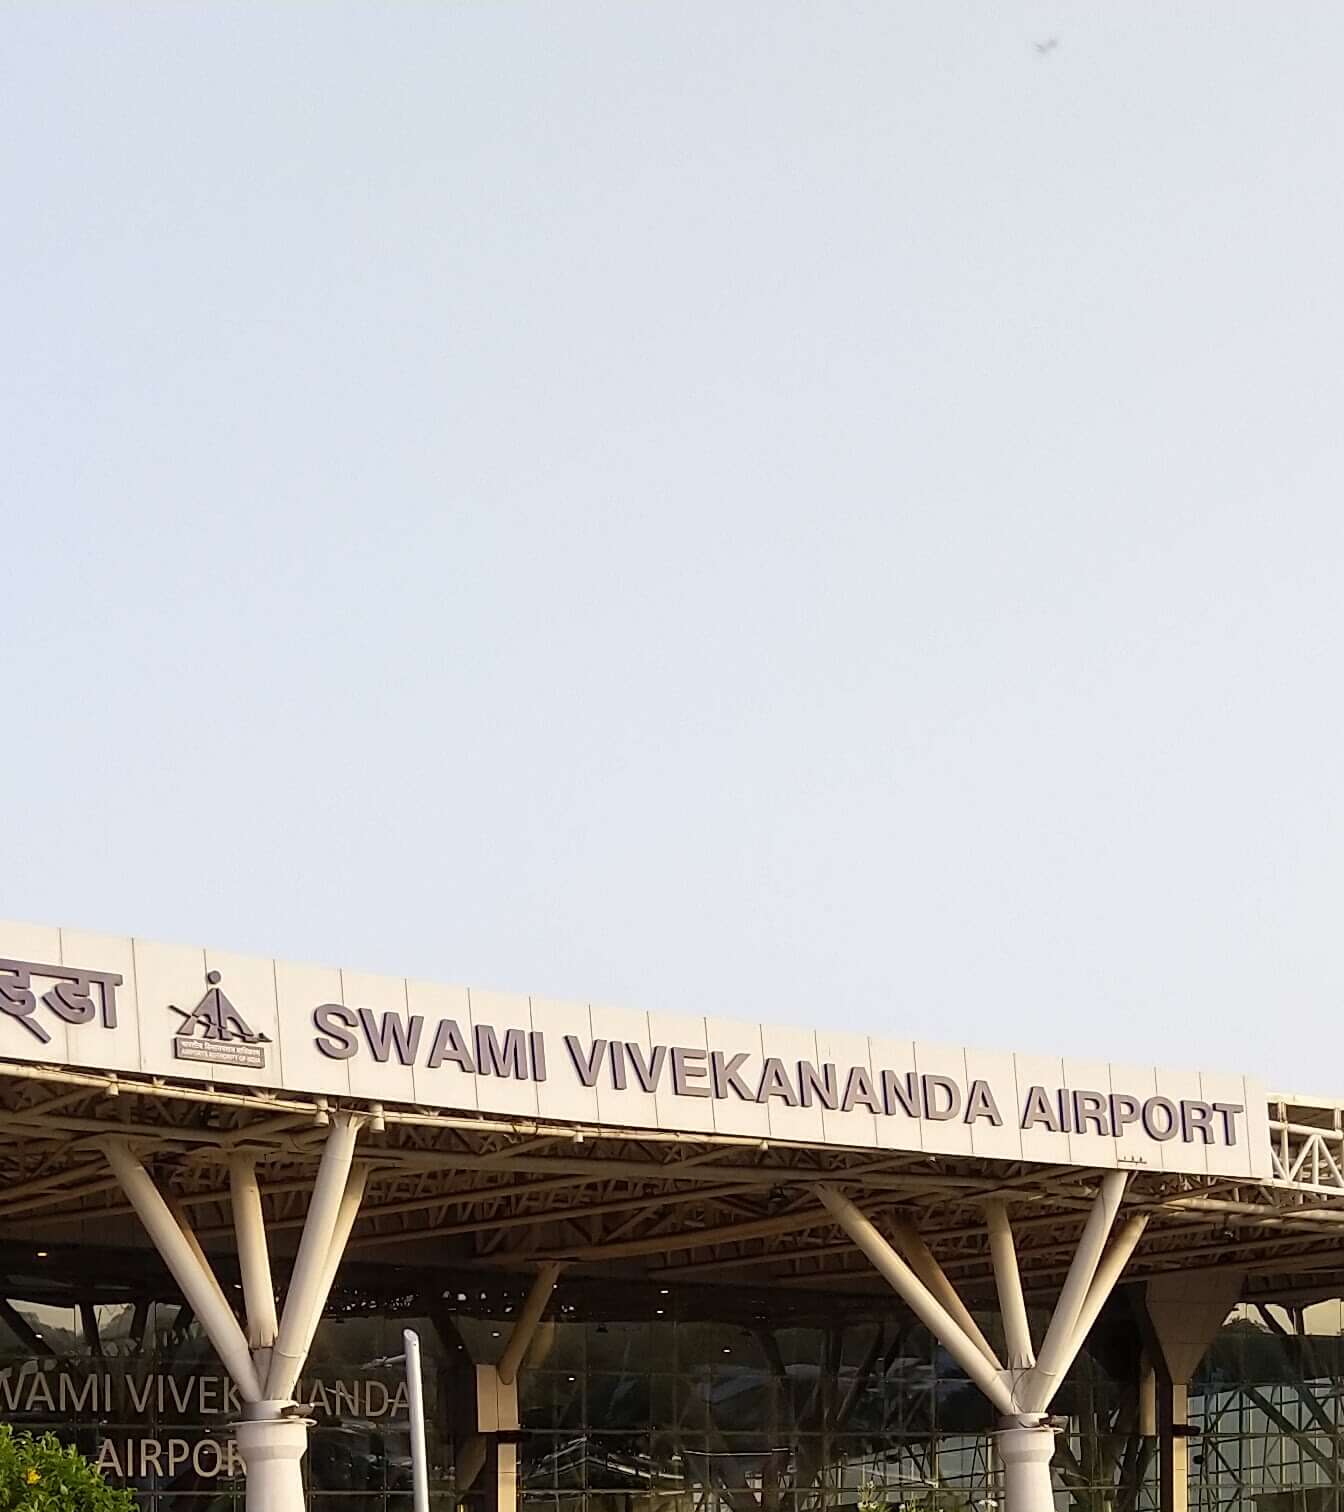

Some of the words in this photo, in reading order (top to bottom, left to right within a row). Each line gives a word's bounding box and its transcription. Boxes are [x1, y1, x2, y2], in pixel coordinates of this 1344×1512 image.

[312, 1002, 547, 1082] SWAMI
[564, 1034, 1003, 1127] VIVEKANANDA
[1020, 1085, 1245, 1146] AIRPORT
[126, 1374, 408, 1418] VIVEKANDA
[96, 1438, 246, 1479] AIRPOR
